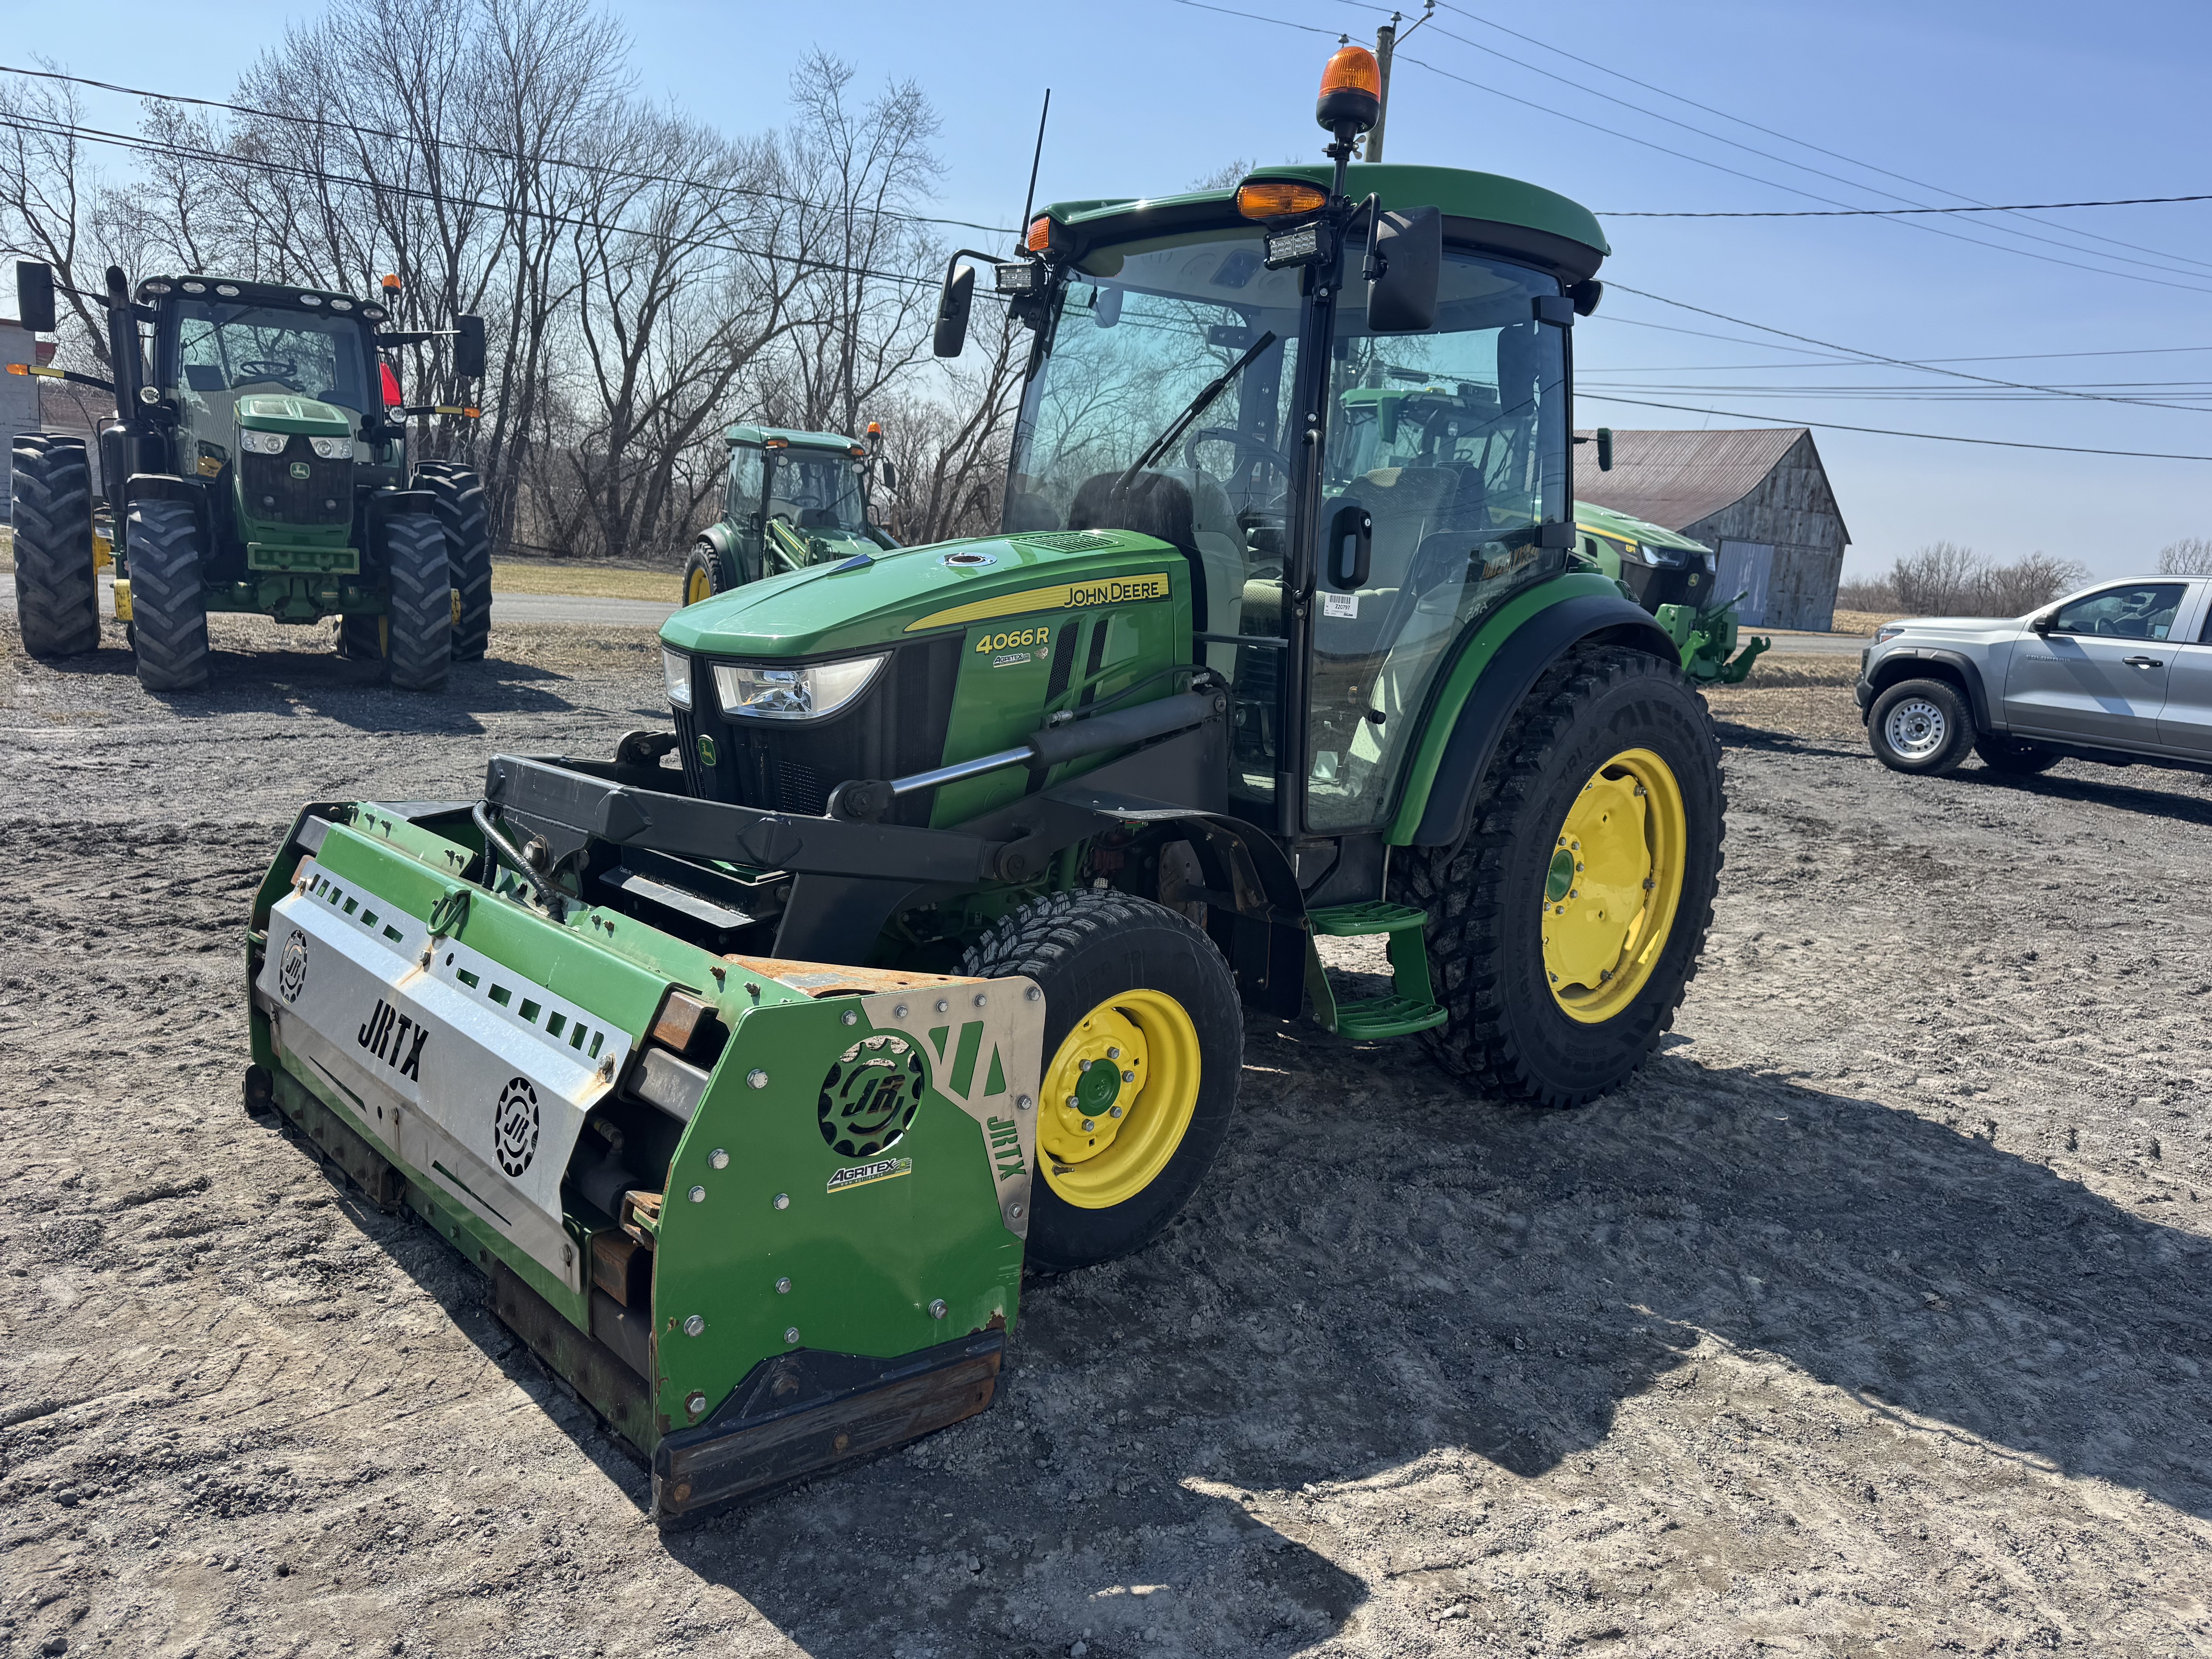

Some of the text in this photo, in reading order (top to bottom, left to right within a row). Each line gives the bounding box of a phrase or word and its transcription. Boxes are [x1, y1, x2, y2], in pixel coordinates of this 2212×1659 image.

[1626, 544, 1635, 553] 8R
[1064, 582, 1159, 606] JOHN DEERE
[994, 654, 1022, 663] AGRITEX
[285, 956, 301, 979] JR
[358, 998, 429, 1083] JRTX
[841, 1074, 905, 1118] JR
[503, 1113, 530, 1144] JR
[987, 1116, 1027, 1182] JRTX
[828, 1159, 895, 1184] AGRITEX
